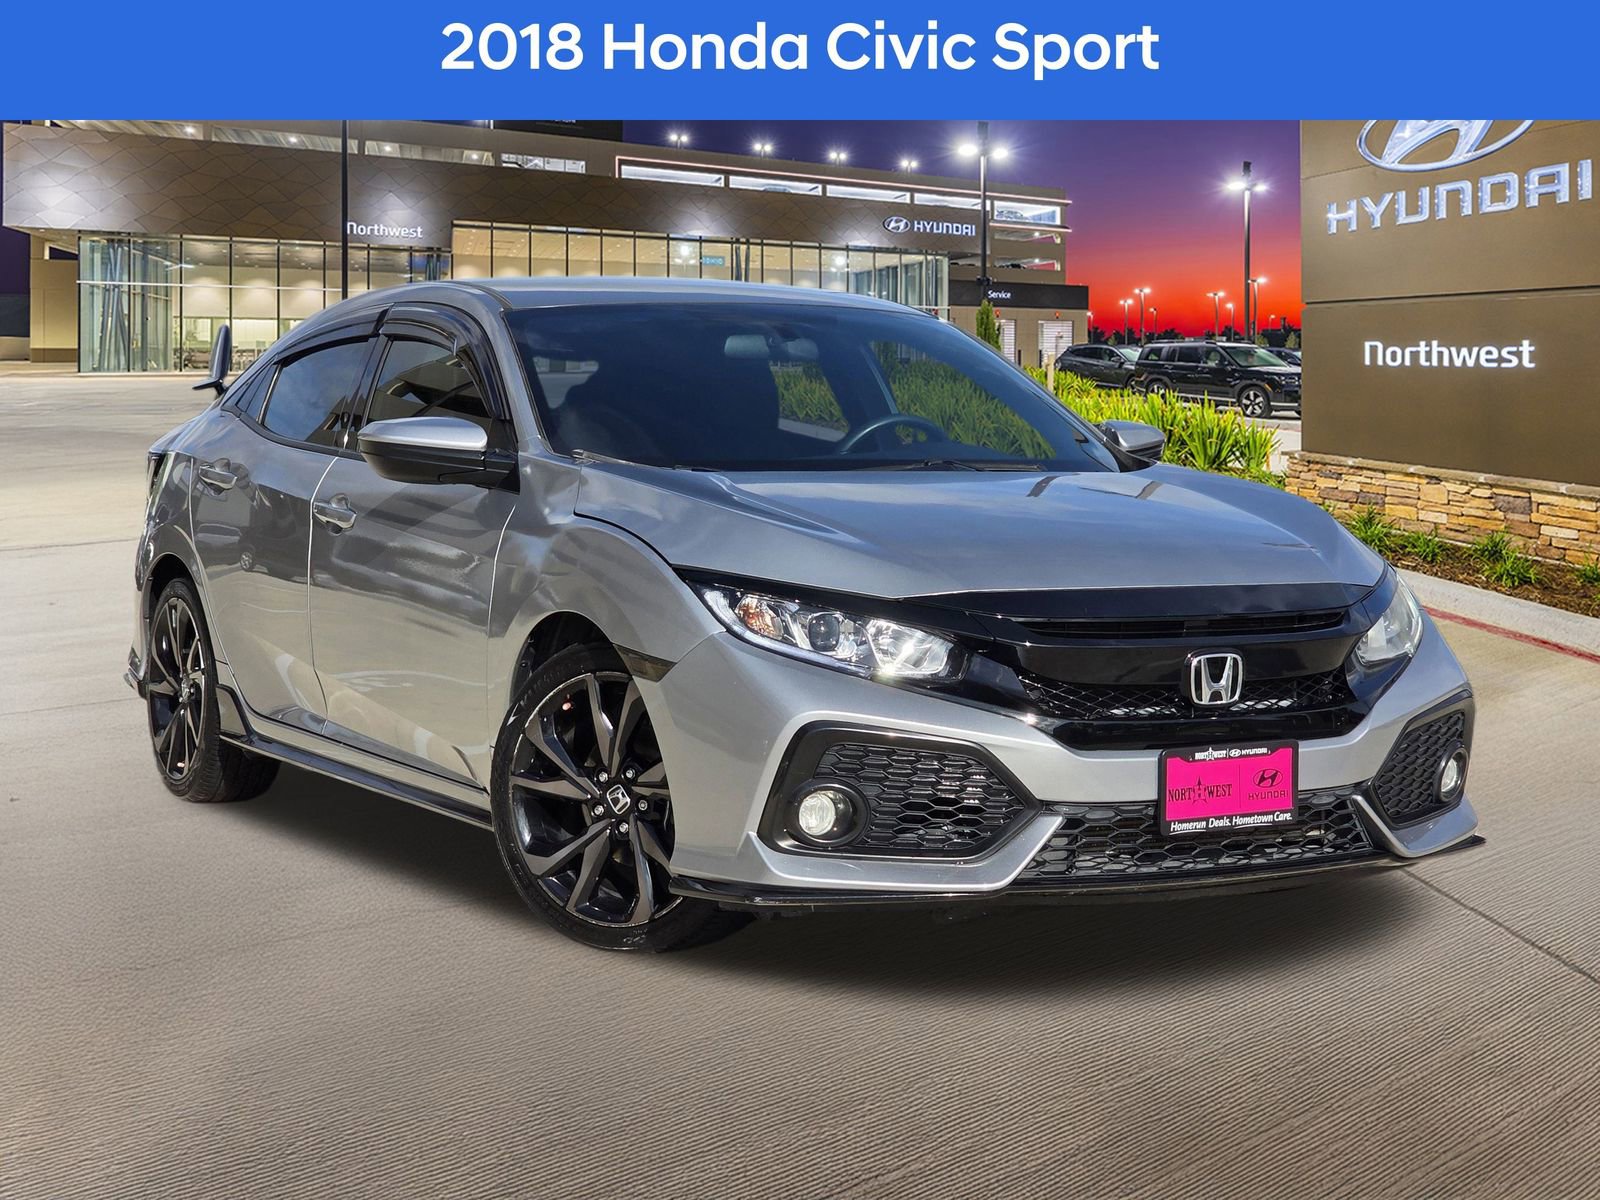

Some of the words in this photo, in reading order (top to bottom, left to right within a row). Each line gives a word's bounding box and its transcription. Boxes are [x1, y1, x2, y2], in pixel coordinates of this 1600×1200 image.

[1327, 159, 1593, 234] HYUNDAI
[347, 221, 423, 238] Northwest
[914, 220, 976, 236] HYUNDAI
[988, 290, 1012, 299] Service
[1363, 340, 1536, 369] Northwest
[1241, 747, 1268, 756] HYUNDAI
[1248, 789, 1289, 801] HYUNDAI
[1170, 820, 1206, 832] Homerun
[1208, 817, 1231, 828] Deals.
[1232, 812, 1273, 826] Hometown
[1274, 811, 1293, 822] Care.
